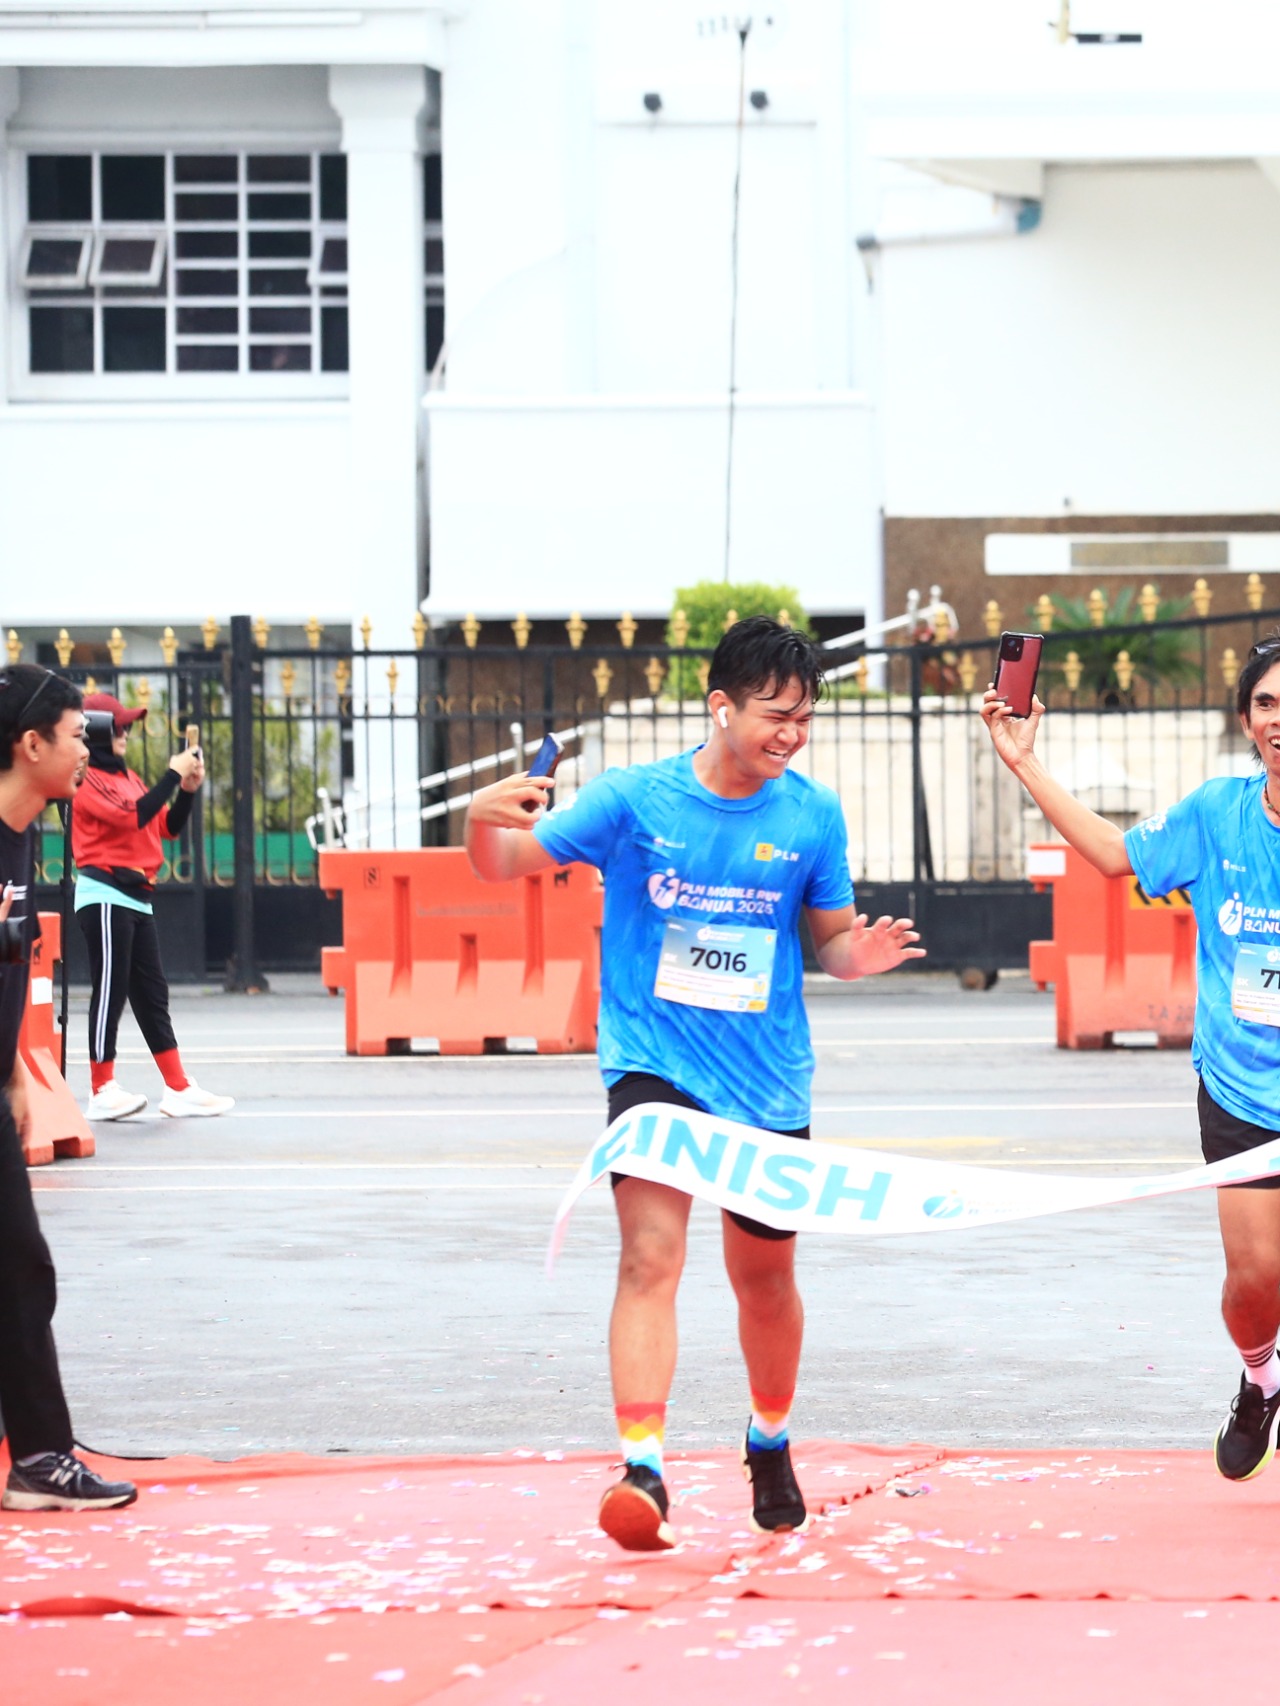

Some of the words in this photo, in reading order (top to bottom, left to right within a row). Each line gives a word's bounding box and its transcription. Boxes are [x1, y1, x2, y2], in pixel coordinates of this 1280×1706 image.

[773, 849, 799, 862] PLN
[680, 883, 706, 896] PLN
[706, 885, 755, 900] MOBILE
[756, 890, 782, 902] RUN
[678, 895, 734, 913] BANUA
[735, 900, 774, 914] 2025
[1243, 906, 1267, 918] PLN
[690, 946, 747, 972] 7016
